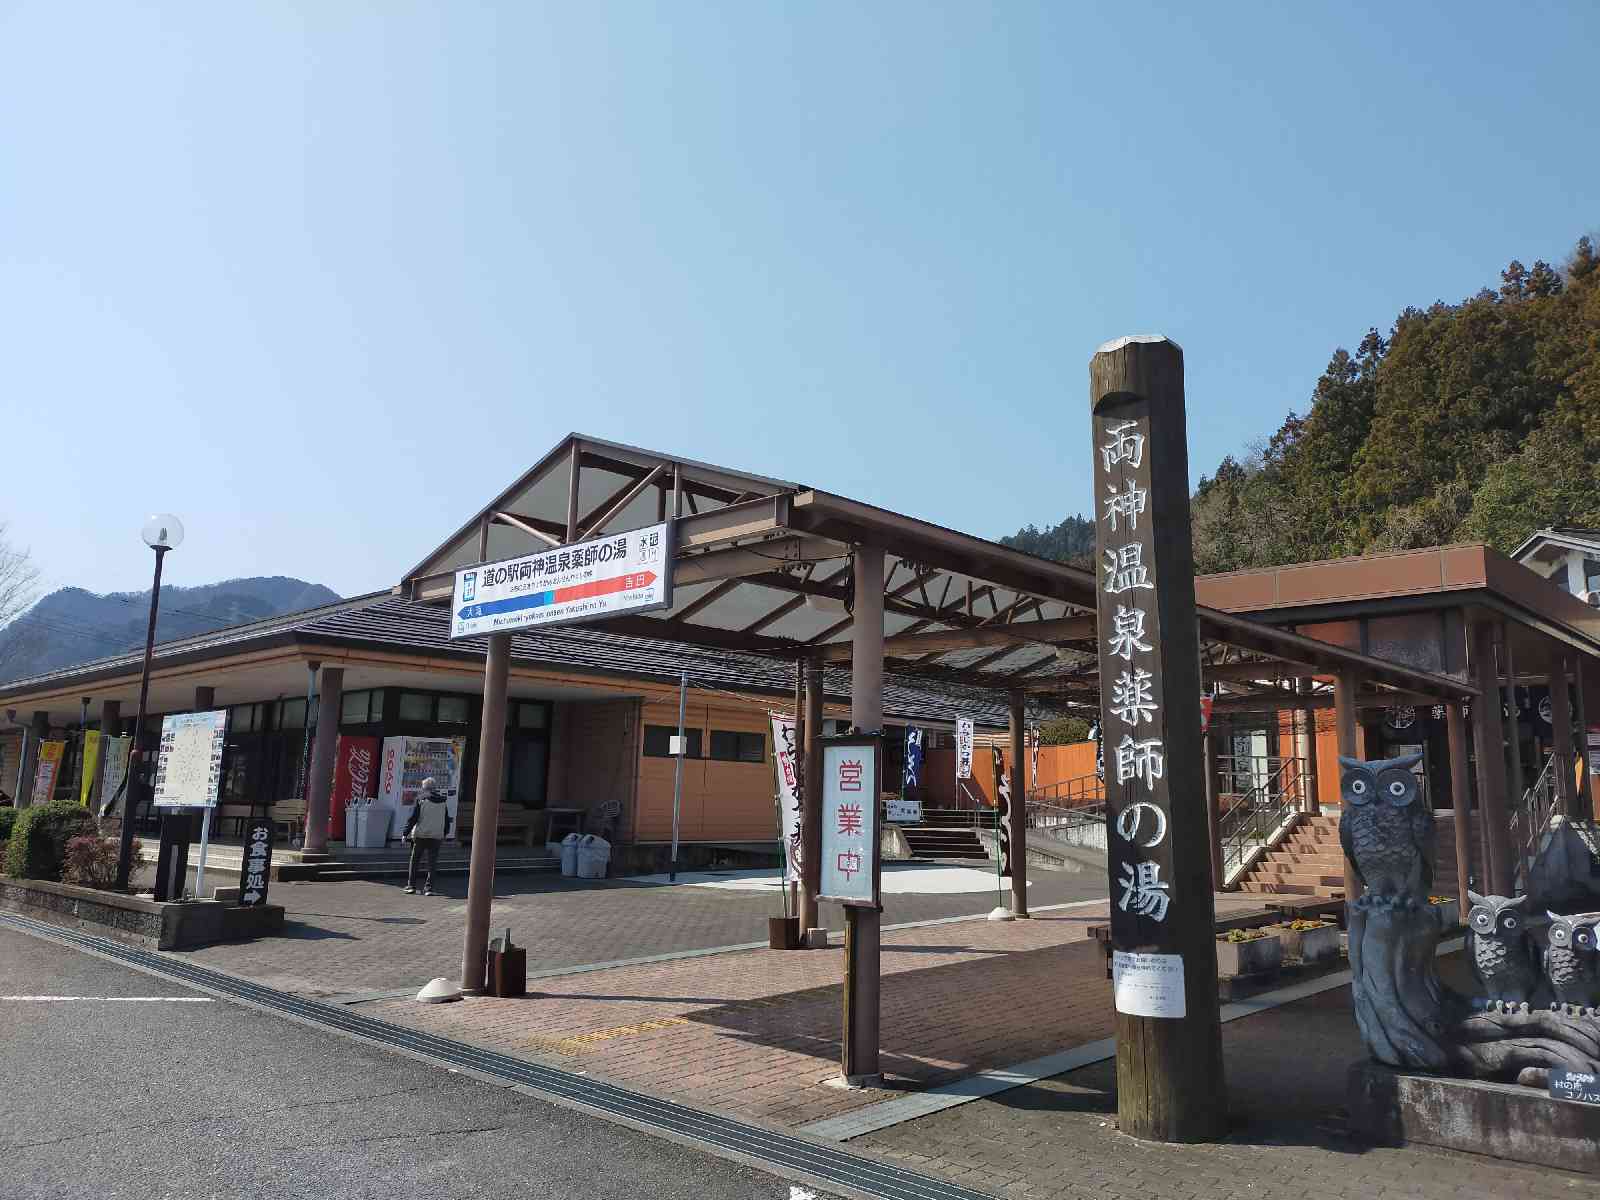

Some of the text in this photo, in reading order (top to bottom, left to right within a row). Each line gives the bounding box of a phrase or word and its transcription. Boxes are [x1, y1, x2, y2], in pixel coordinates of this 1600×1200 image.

[482, 537, 627, 588] 道の駅両神温泉薬師の湯
[1101, 418, 1171, 923] 両神温泉薬師の湯
[246, 826, 269, 890] お食事処
[837, 759, 863, 882] 営業中
